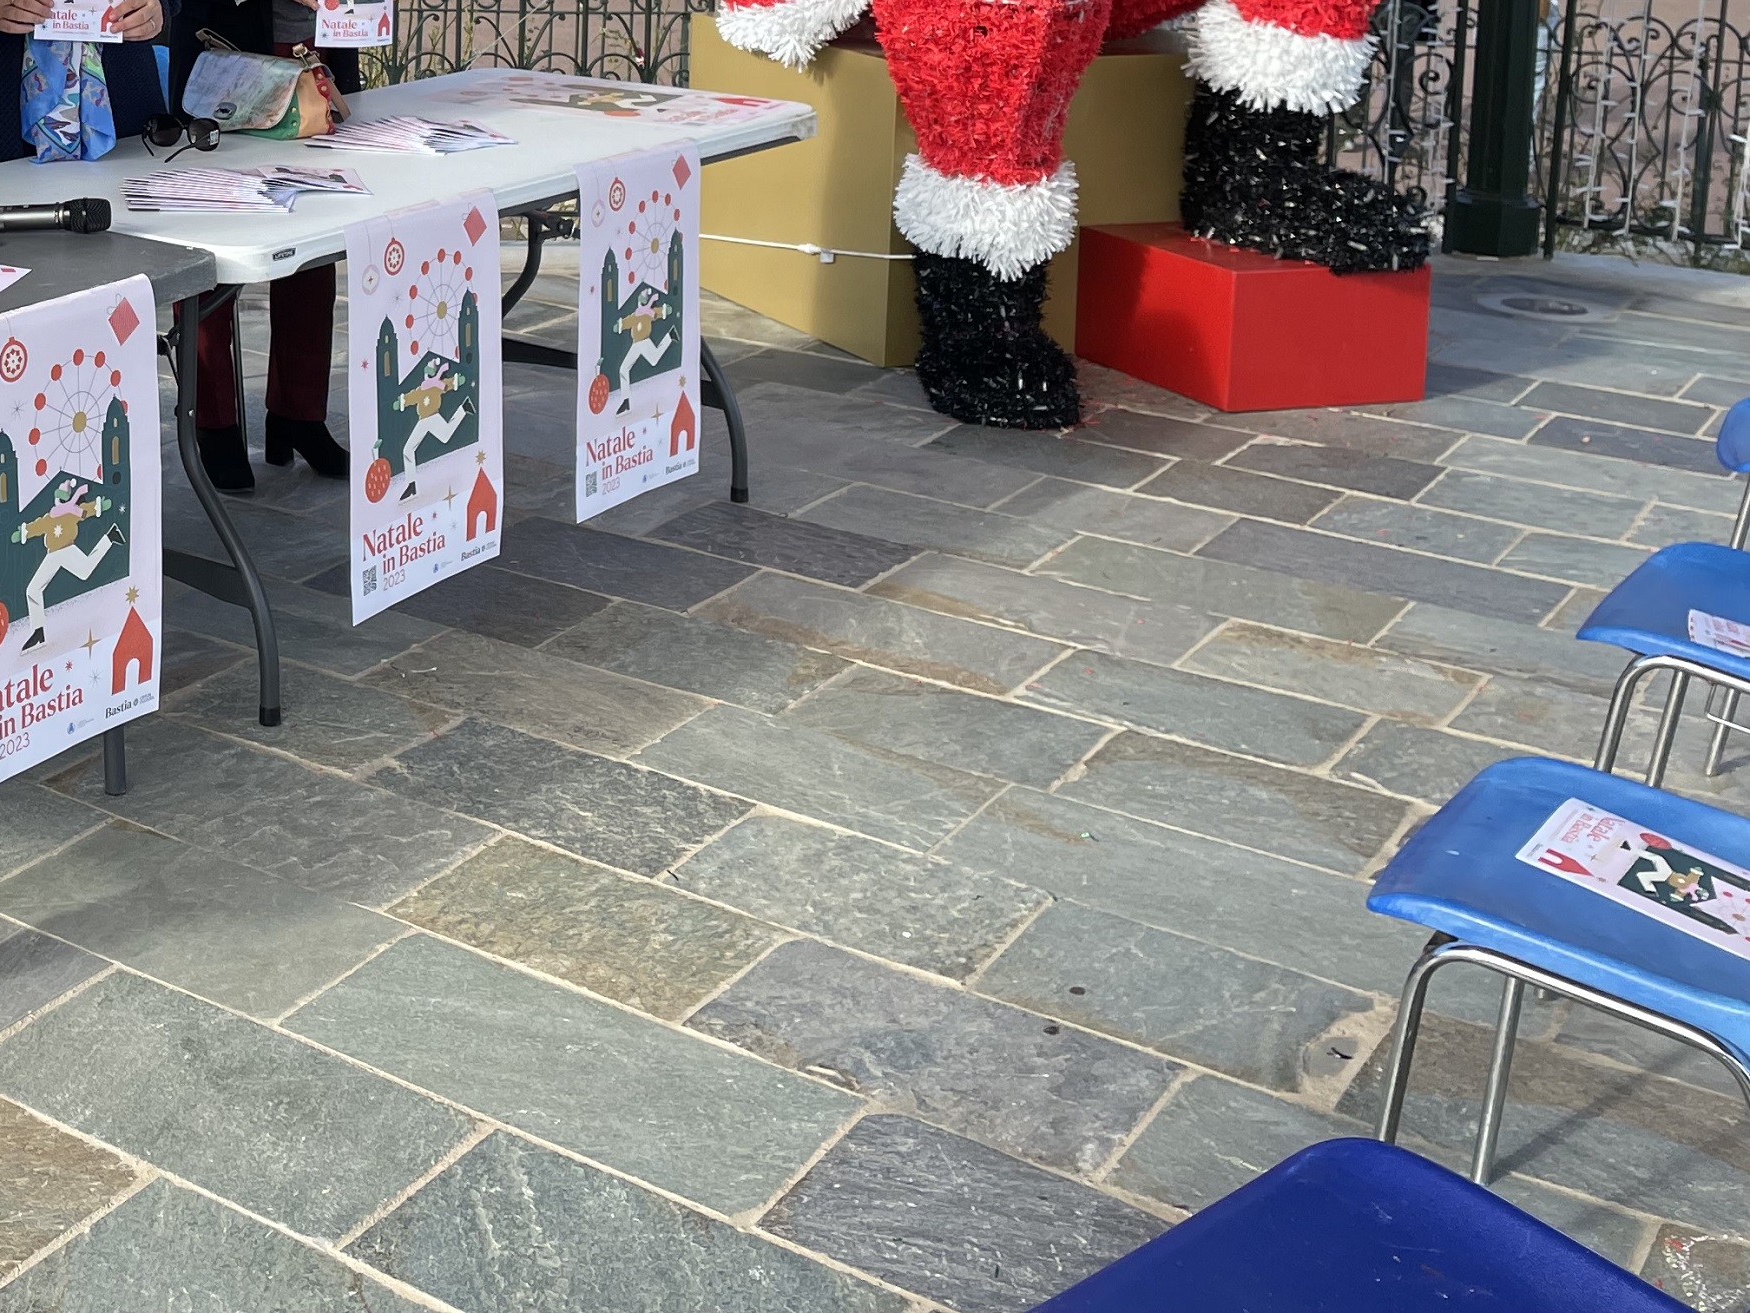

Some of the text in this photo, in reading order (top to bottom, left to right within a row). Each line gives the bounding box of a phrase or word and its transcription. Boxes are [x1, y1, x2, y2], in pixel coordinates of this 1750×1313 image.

[52, 20, 89, 30] in Bastia
[322, 19, 357, 30] Natale
[343, 29, 369, 38] Bastia
[586, 426, 636, 467] Natale
[602, 445, 653, 481] in Bastia
[602, 476, 621, 495] 2023
[362, 512, 424, 562] Natale
[382, 531, 446, 575] in Bastia
[460, 546, 481, 561] Bastia
[383, 569, 406, 592] 2023
[20, 684, 84, 729] Bastia
[105, 700, 132, 719] Bastia
[0, 732, 31, 760] 2023
